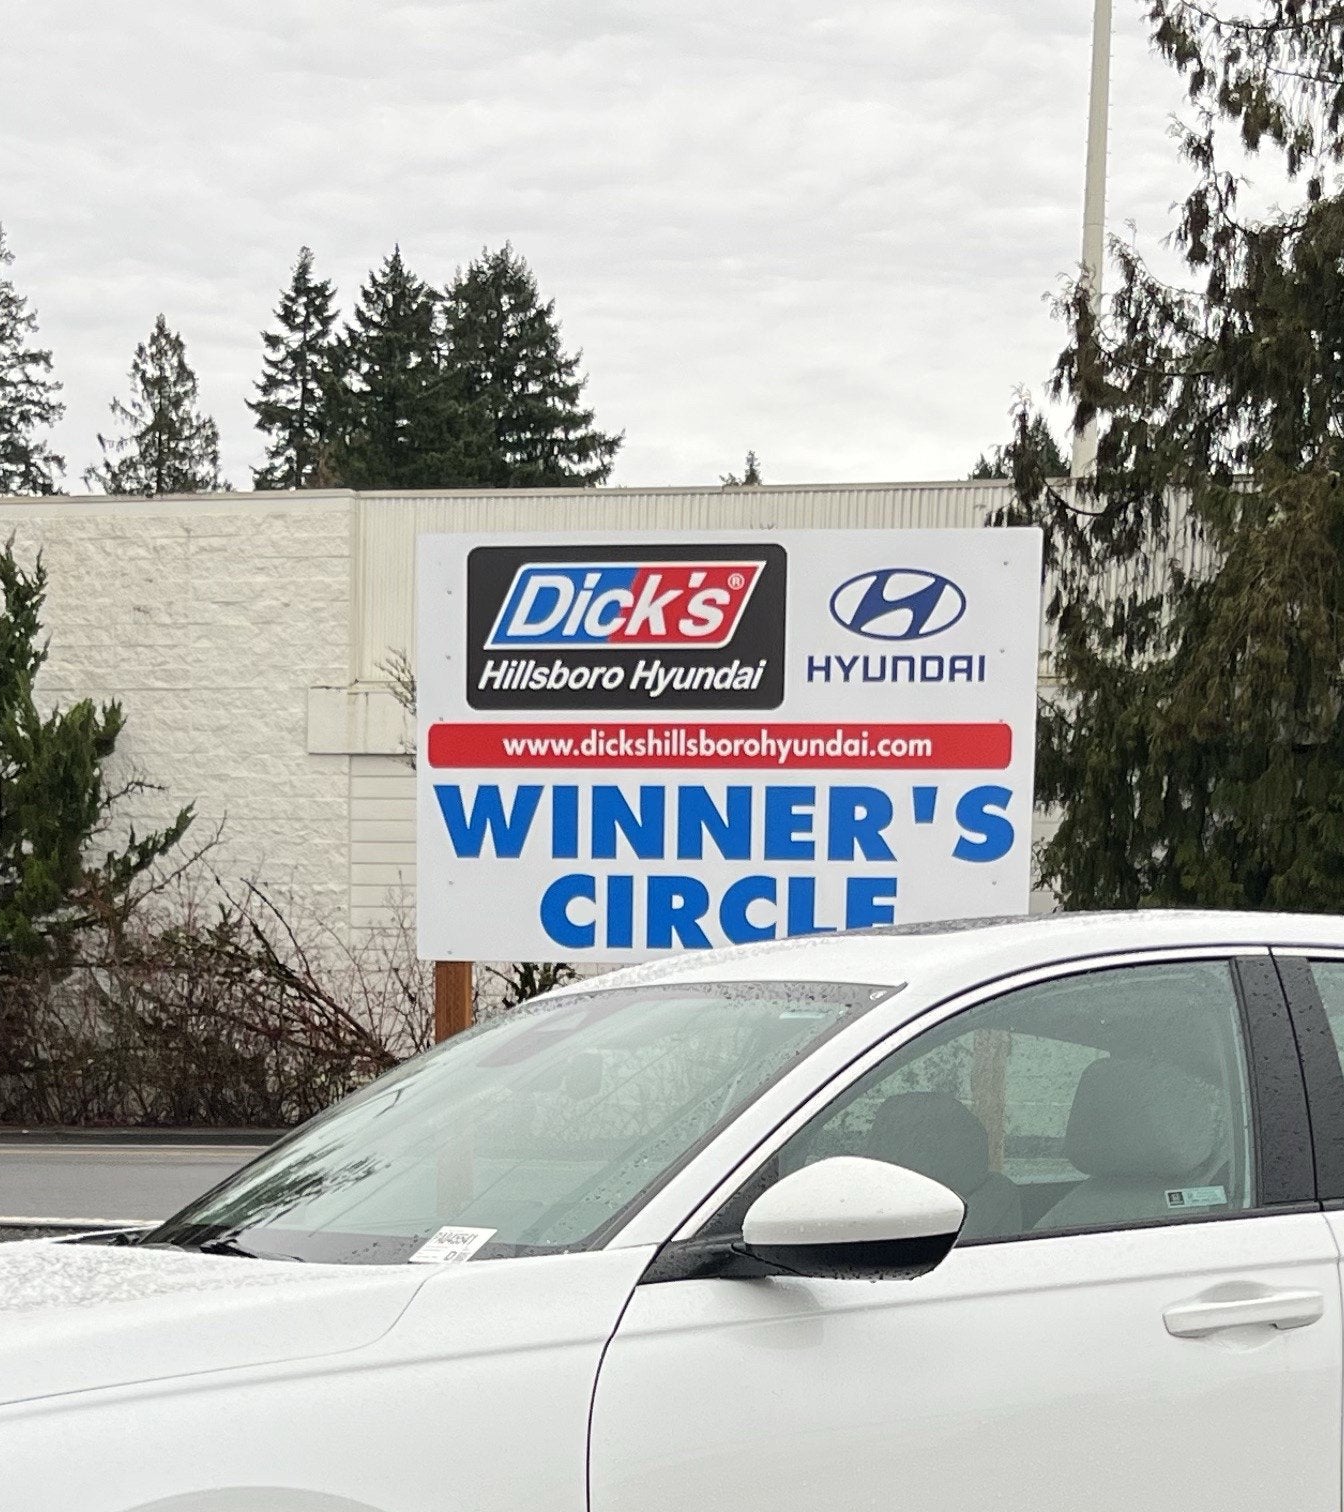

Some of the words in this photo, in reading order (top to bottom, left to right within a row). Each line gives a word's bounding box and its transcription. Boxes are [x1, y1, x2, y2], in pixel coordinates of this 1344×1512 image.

[506, 571, 730, 638] Dick's
[477, 659, 623, 691] Hillsboro
[629, 659, 768, 697] Hyundai
[807, 654, 986, 683] HYUNDAI
[501, 731, 933, 765] www.dickshillsborohyundai.com
[432, 784, 1016, 863] WINNER'S
[539, 873, 899, 949] CIRCLE
